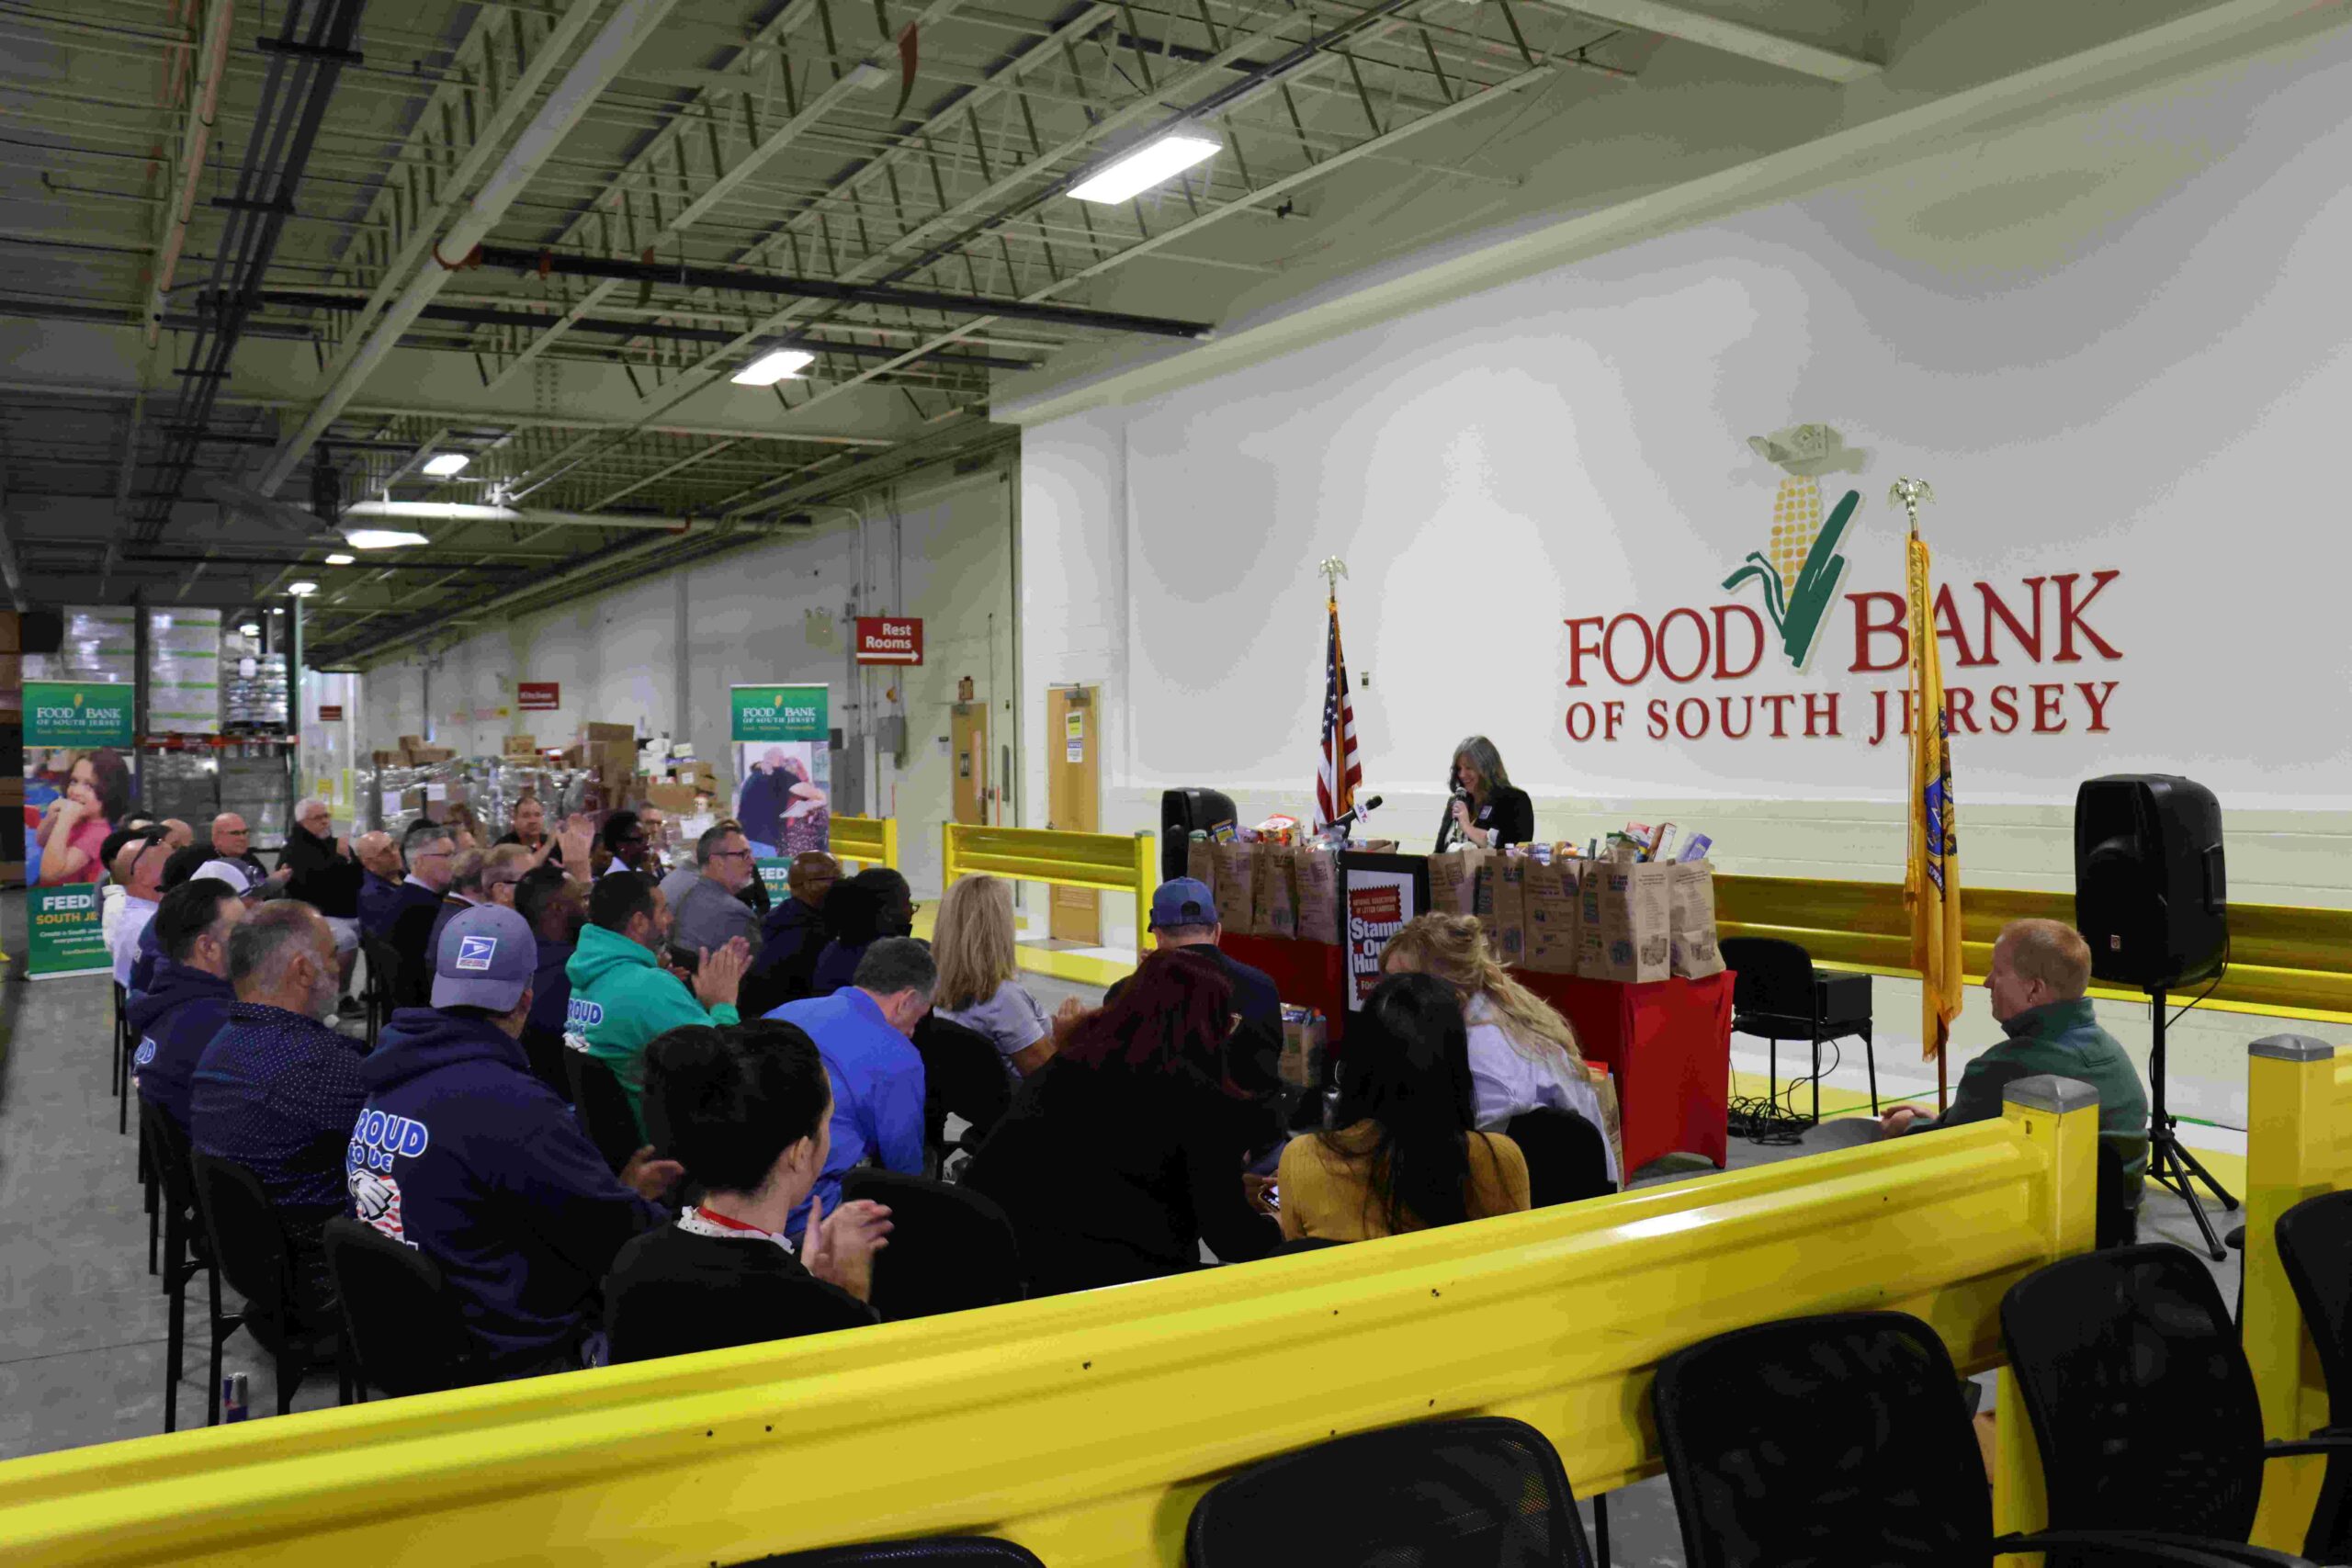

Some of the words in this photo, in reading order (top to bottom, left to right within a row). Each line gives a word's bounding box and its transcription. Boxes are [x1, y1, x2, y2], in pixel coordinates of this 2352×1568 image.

[883, 623, 911, 636] Rest
[1564, 604, 1763, 686] FOOD
[1844, 570, 2123, 672] BANK
[865, 636, 911, 649] Rooms
[37, 707, 74, 718] FOOD
[85, 708, 120, 718] BANK
[742, 707, 775, 717] FOOD
[785, 707, 816, 716] BANK
[1566, 701, 1624, 741] OF
[1647, 693, 1842, 739] SOUTH
[1869, 682, 2120, 745] JERSEY
[36, 912, 81, 924] SOUTH
[351, 1109, 428, 1157] ROUD
